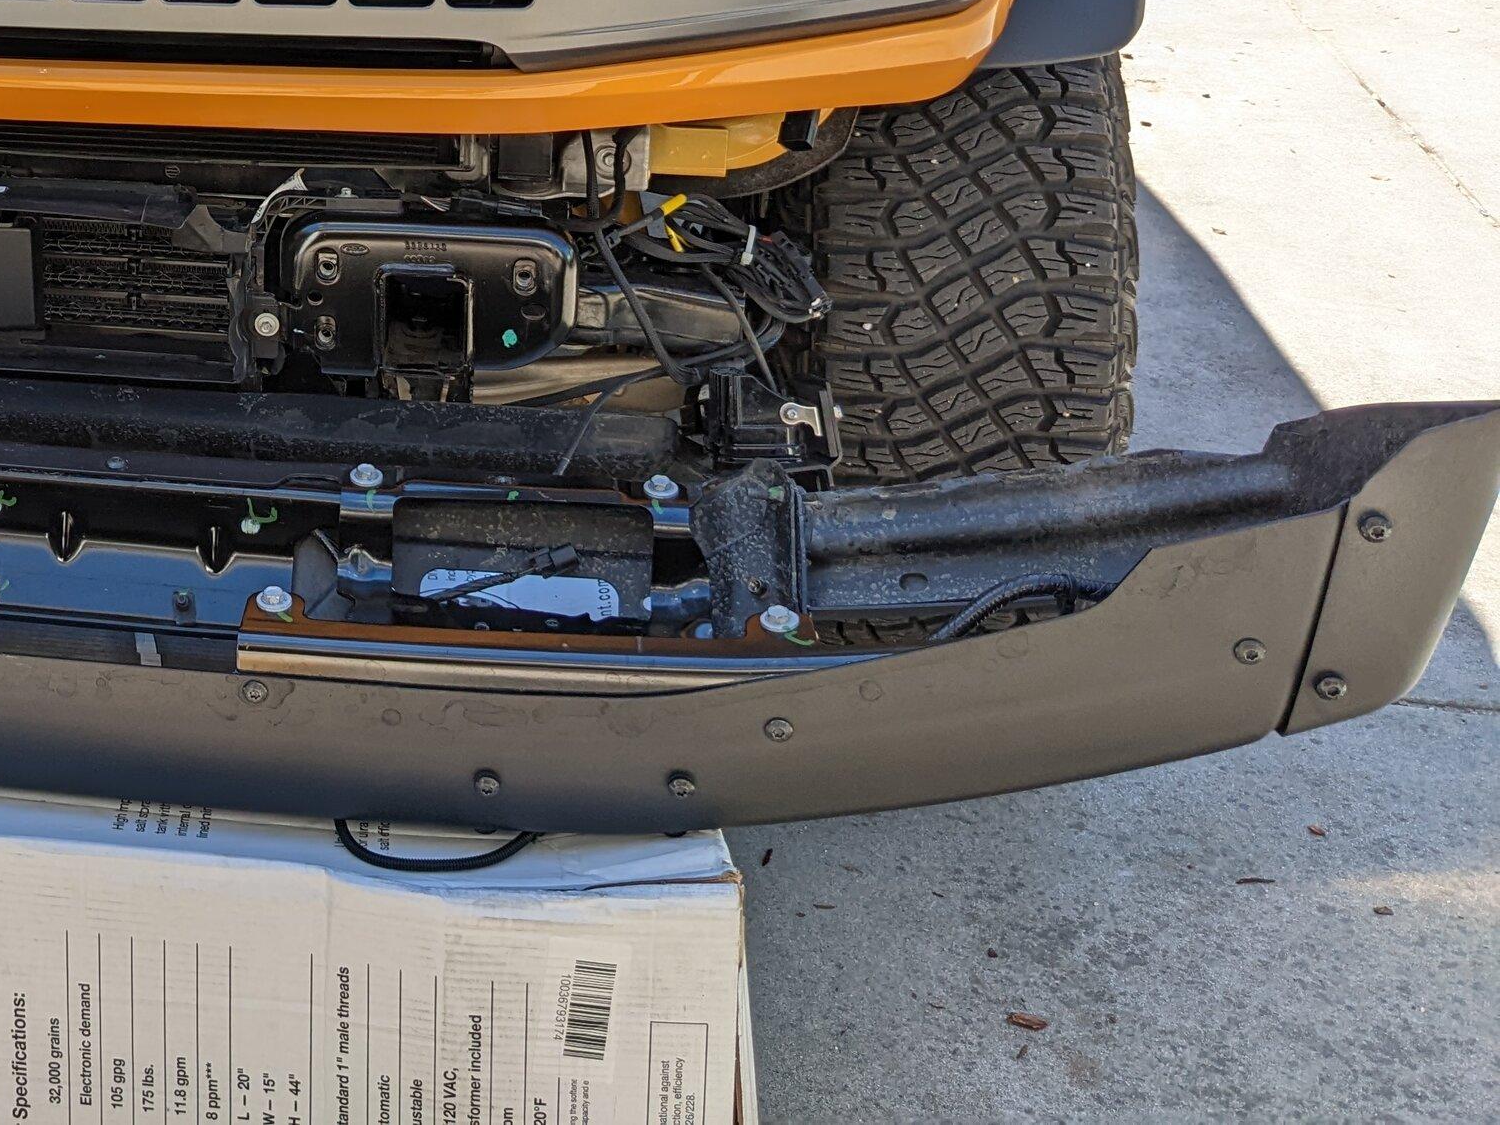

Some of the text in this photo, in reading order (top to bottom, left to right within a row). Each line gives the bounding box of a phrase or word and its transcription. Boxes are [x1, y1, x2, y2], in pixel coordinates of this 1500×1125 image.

[336, 967, 349, 1018] threads
[552, 973, 573, 1041] 10036793174
[10, 992, 31, 1120] Specifications:
[47, 1017, 63, 1105] 32,000 grains
[78, 983, 92, 1106] Electronic demand
[337, 1022, 349, 1055] male
[468, 1014, 482, 1073] included
[111, 1058, 126, 1110] 105 gpg
[142, 1063, 154, 1113] 175 lbs.
[174, 1056, 189, 1116] 11.8 gpm
[237, 1067, 250, 1091] 20"
[262, 1072, 275, 1095] 15"
[288, 1073, 301, 1096] 44"
[443, 1067, 459, 1125] 120 VAC,
[581, 1086, 590, 1099] and
[660, 1060, 671, 1093] against
[672, 1057, 685, 1100] efficiency
[205, 1111, 218, 1121] 8
[237, 1112, 250, 1121] L
[569, 1103, 578, 1115] the
